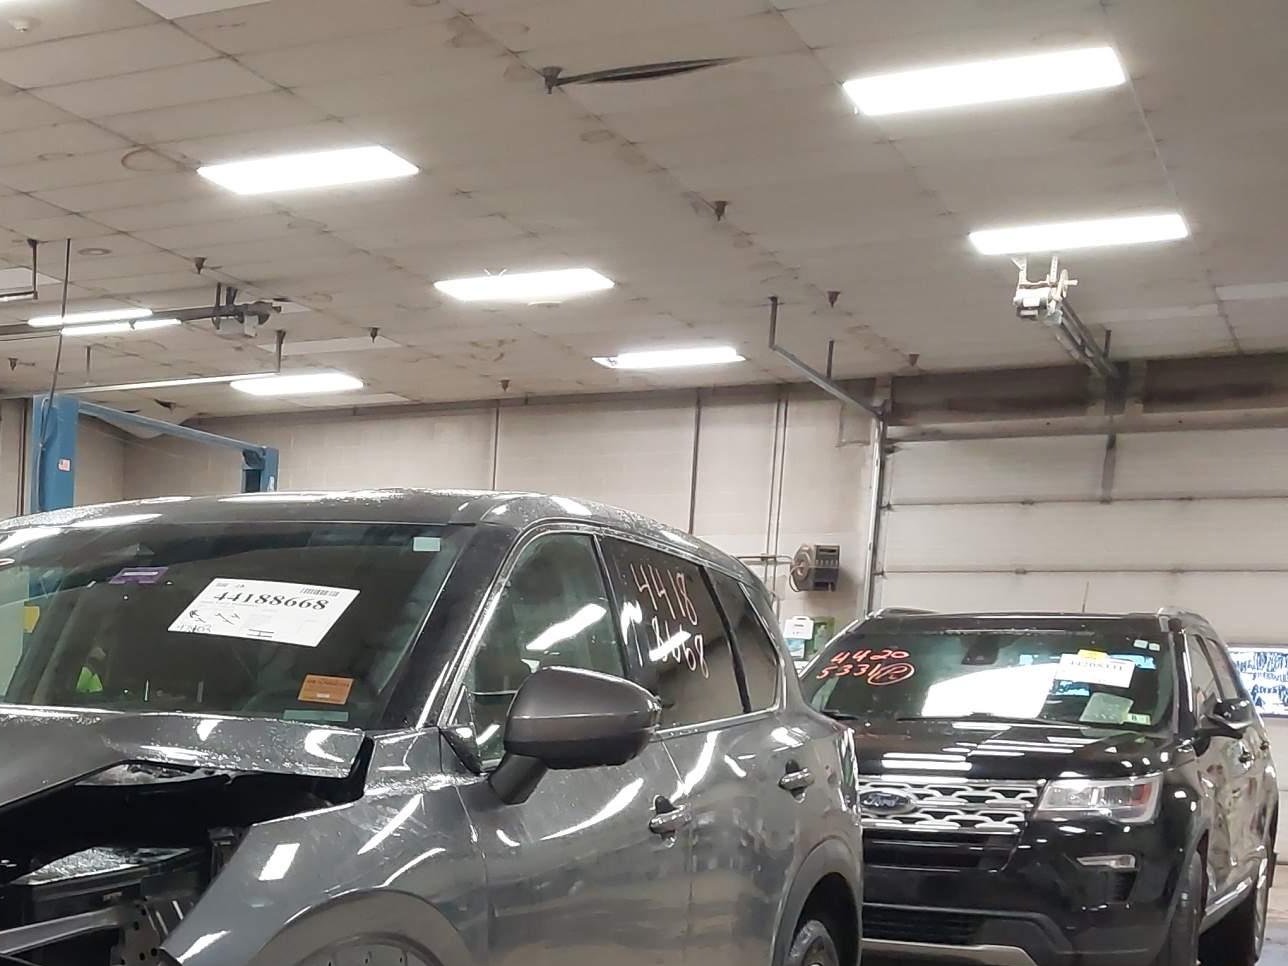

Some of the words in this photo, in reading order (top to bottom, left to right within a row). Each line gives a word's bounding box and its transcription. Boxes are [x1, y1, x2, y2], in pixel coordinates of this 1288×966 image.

[213, 591, 330, 611] 44188668
[630, 563, 698, 626] 4418
[830, 649, 910, 664] 4420
